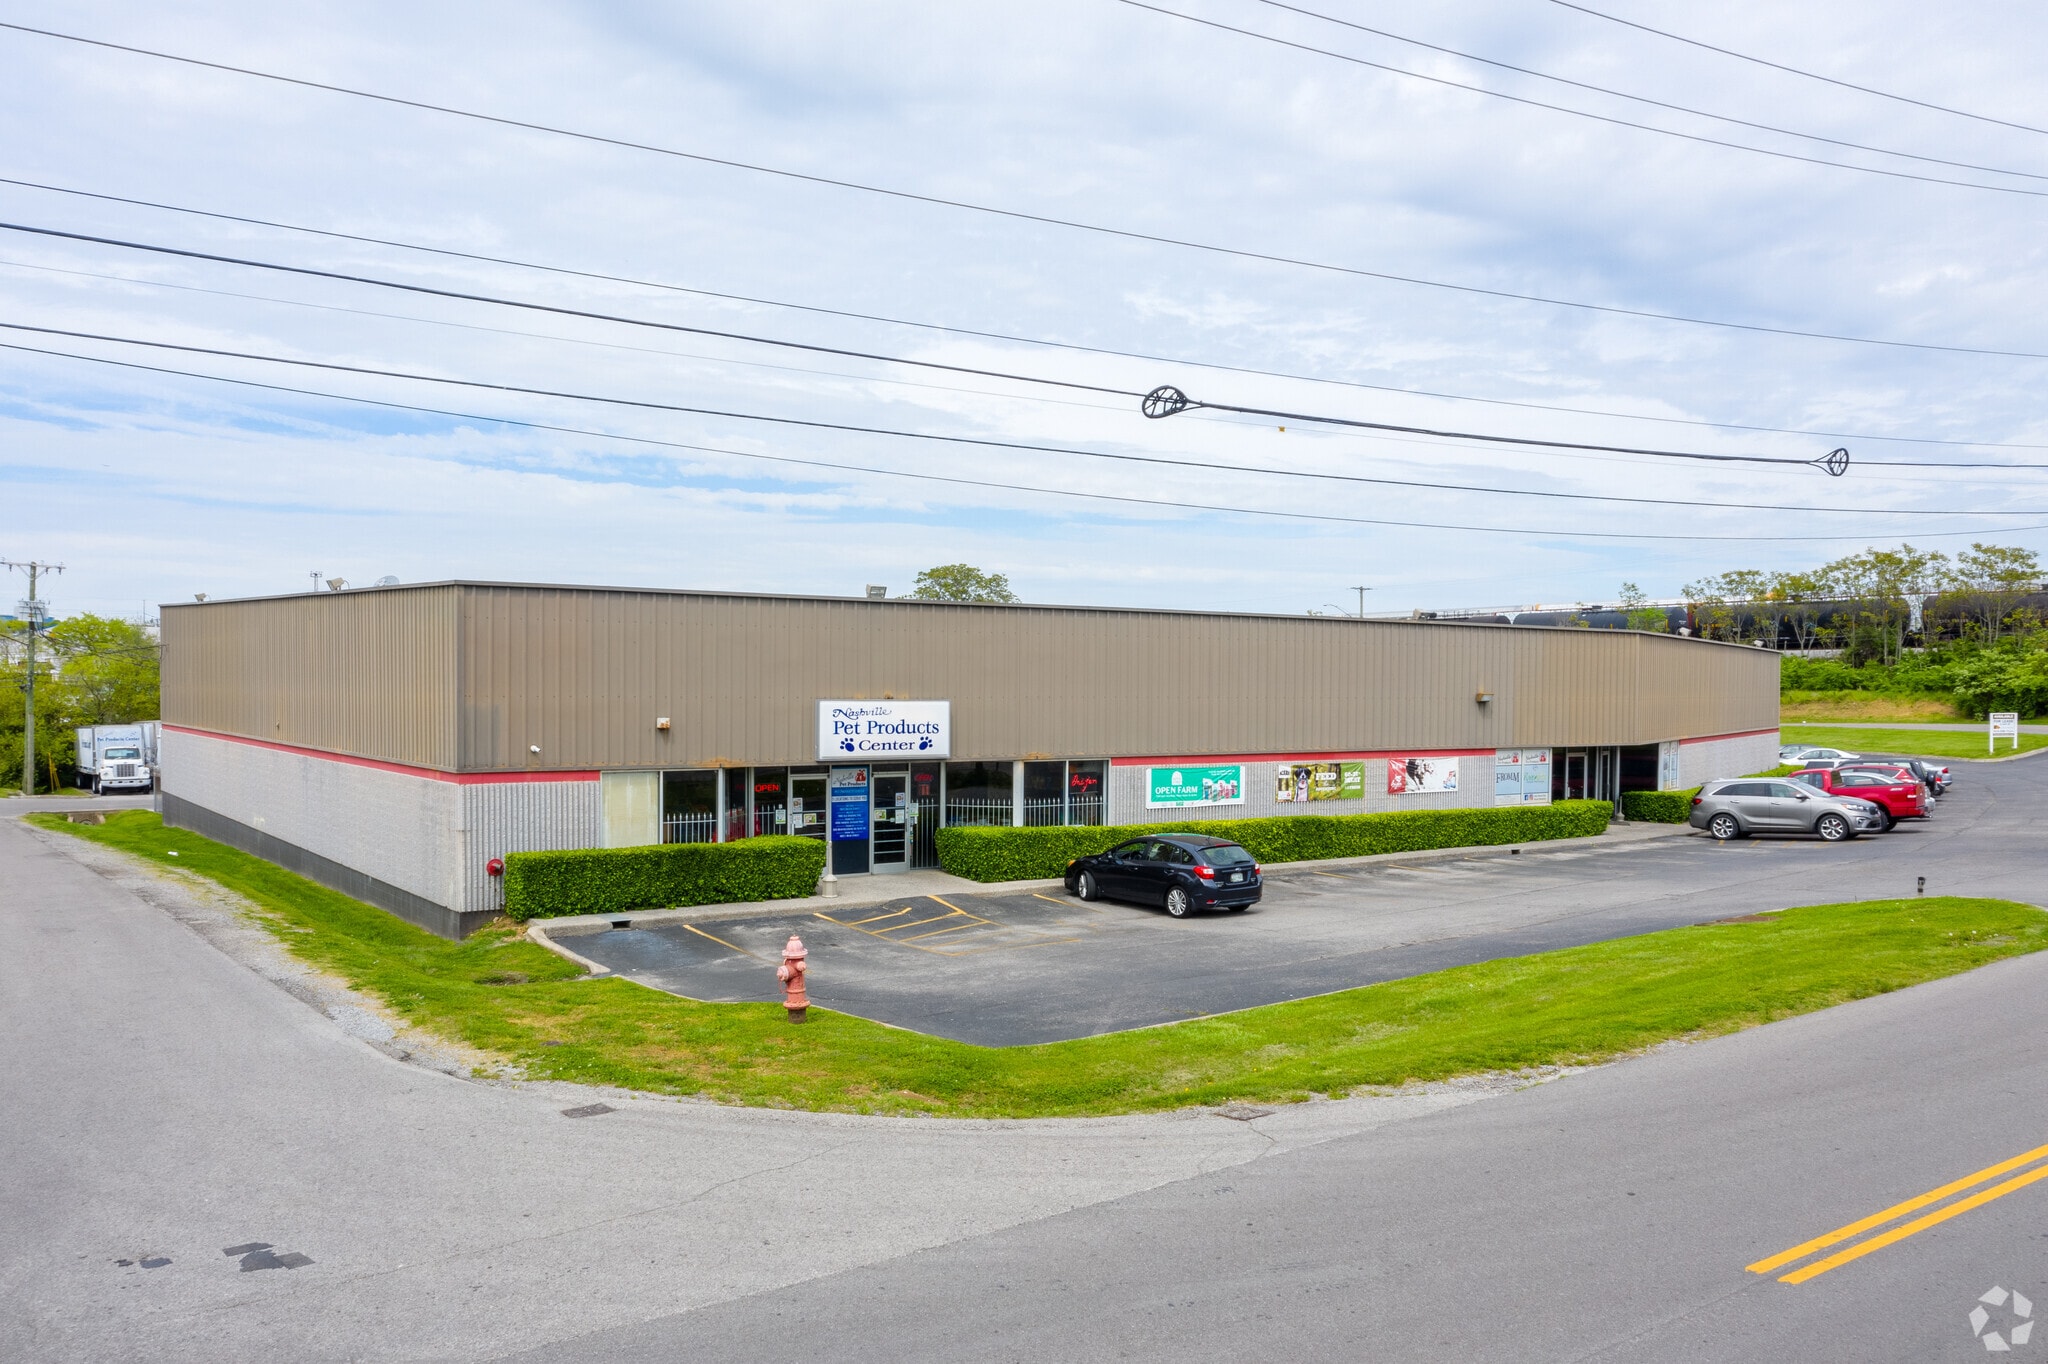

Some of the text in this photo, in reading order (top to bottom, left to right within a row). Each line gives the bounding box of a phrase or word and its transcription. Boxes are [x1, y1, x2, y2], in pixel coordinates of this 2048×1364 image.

[832, 707, 892, 720] Nashville
[833, 718, 940, 735] Pet Products
[858, 739, 916, 751] Center
[1496, 772, 1520, 783] FROMM
[754, 783, 780, 792] OPEN
[1155, 785, 1198, 794] OPEN FARM
